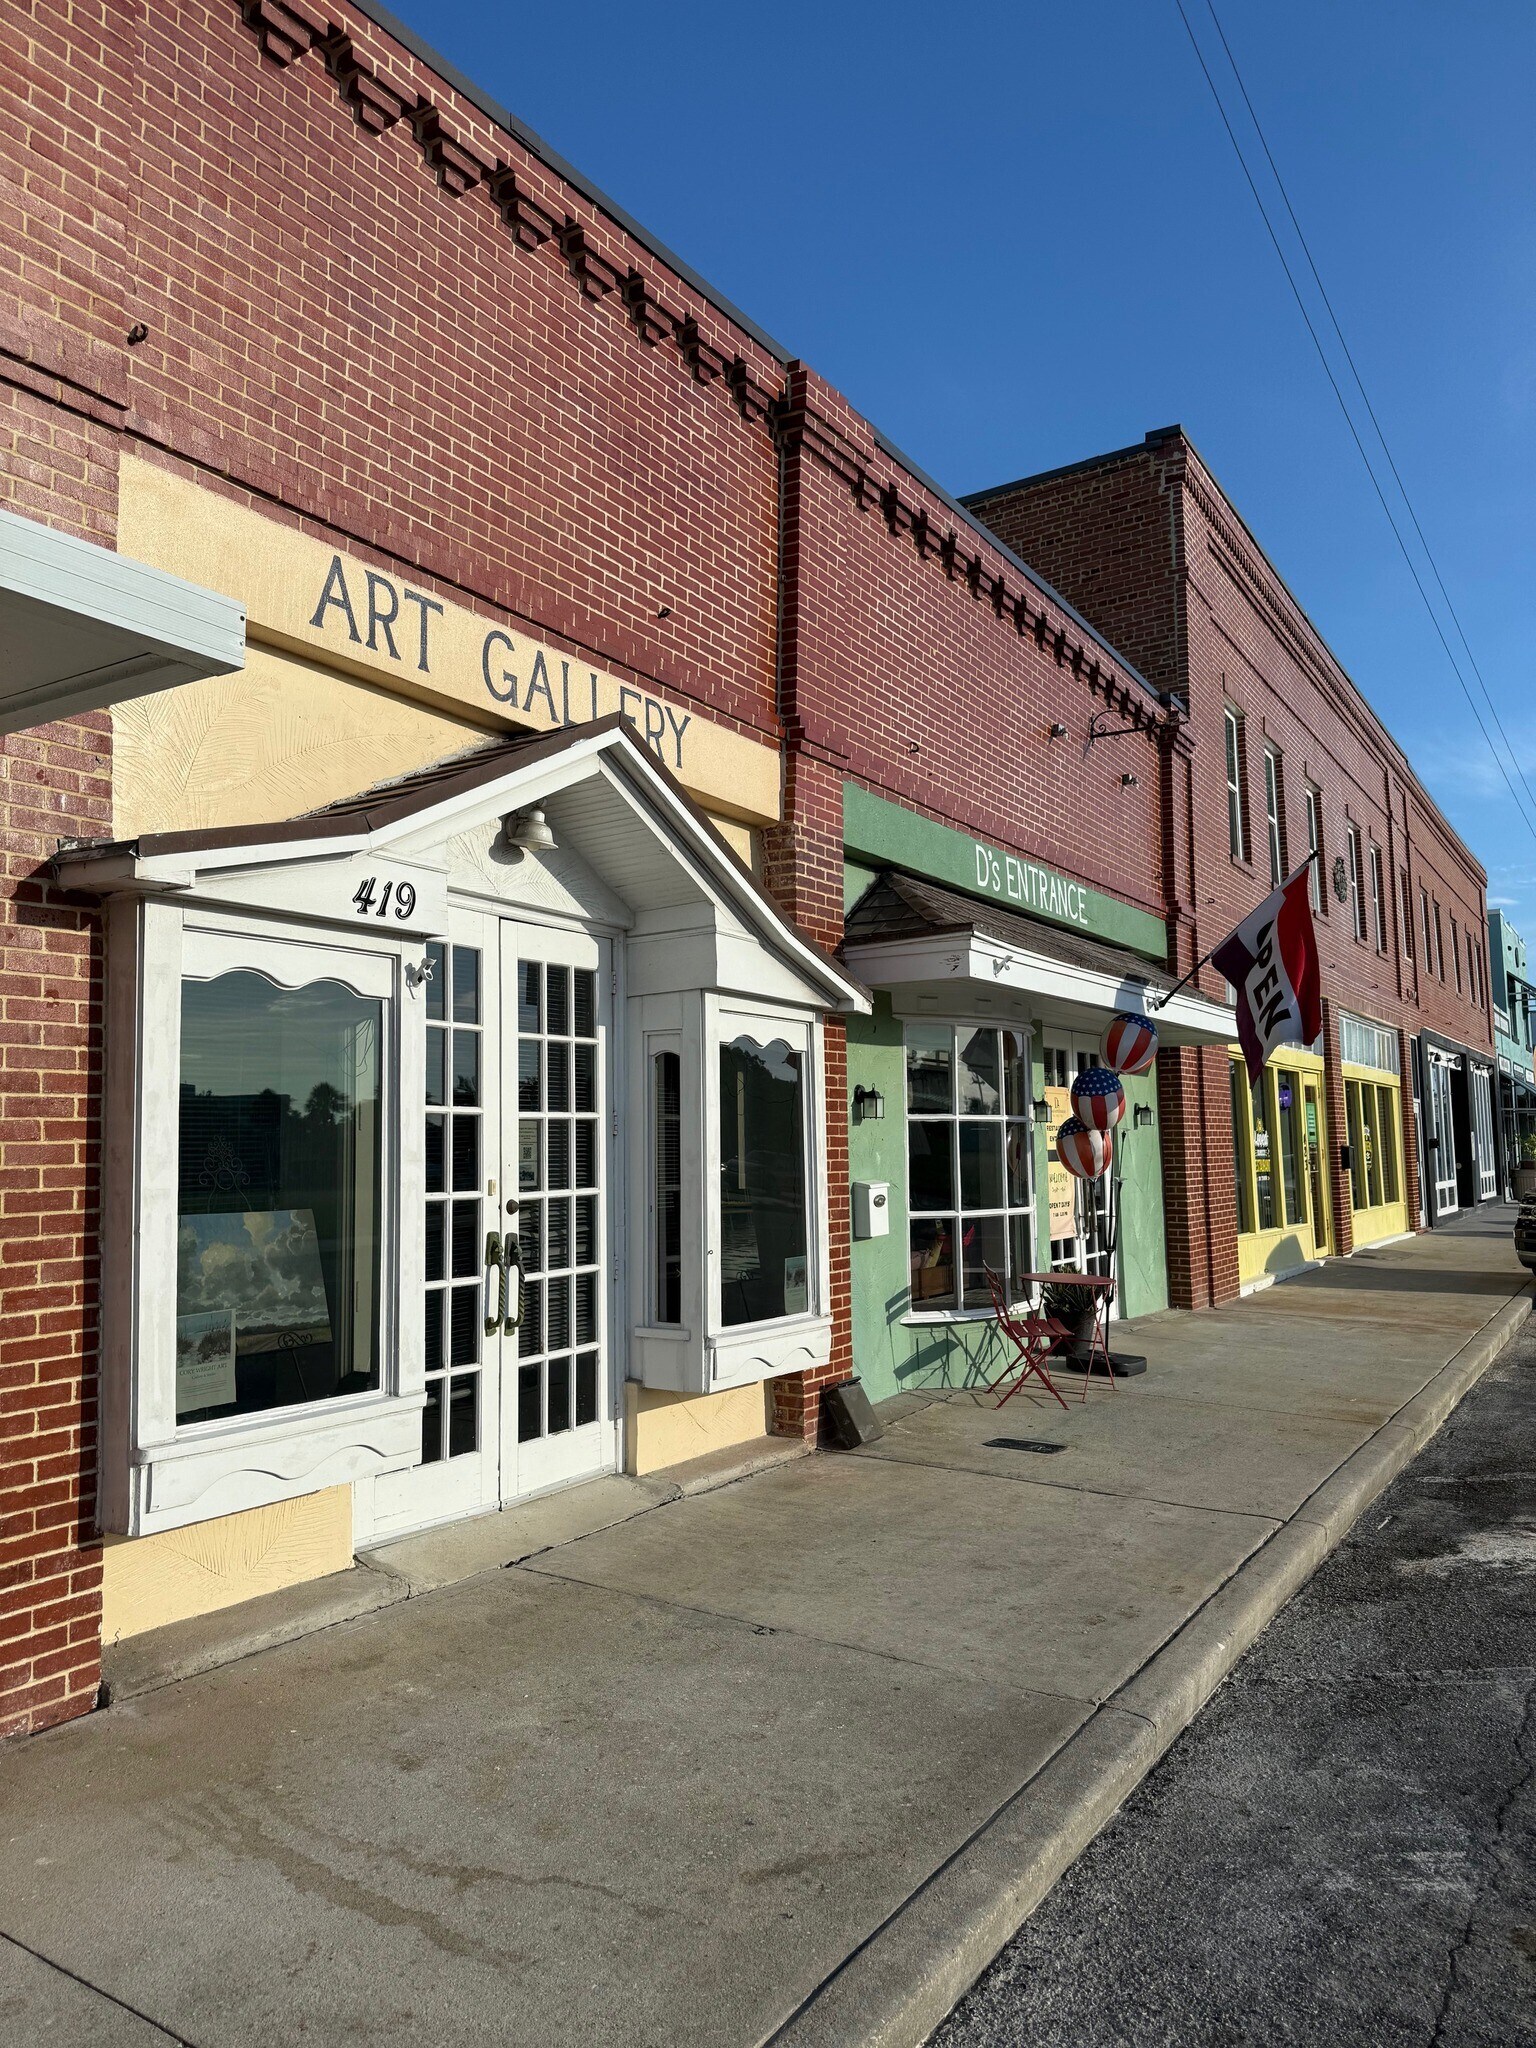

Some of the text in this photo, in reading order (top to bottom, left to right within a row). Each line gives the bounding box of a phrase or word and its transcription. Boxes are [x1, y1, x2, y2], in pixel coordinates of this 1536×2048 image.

[309, 555, 443, 673] ART
[352, 876, 417, 920] 419
[975, 844, 1088, 925] D's ENTRANCE
